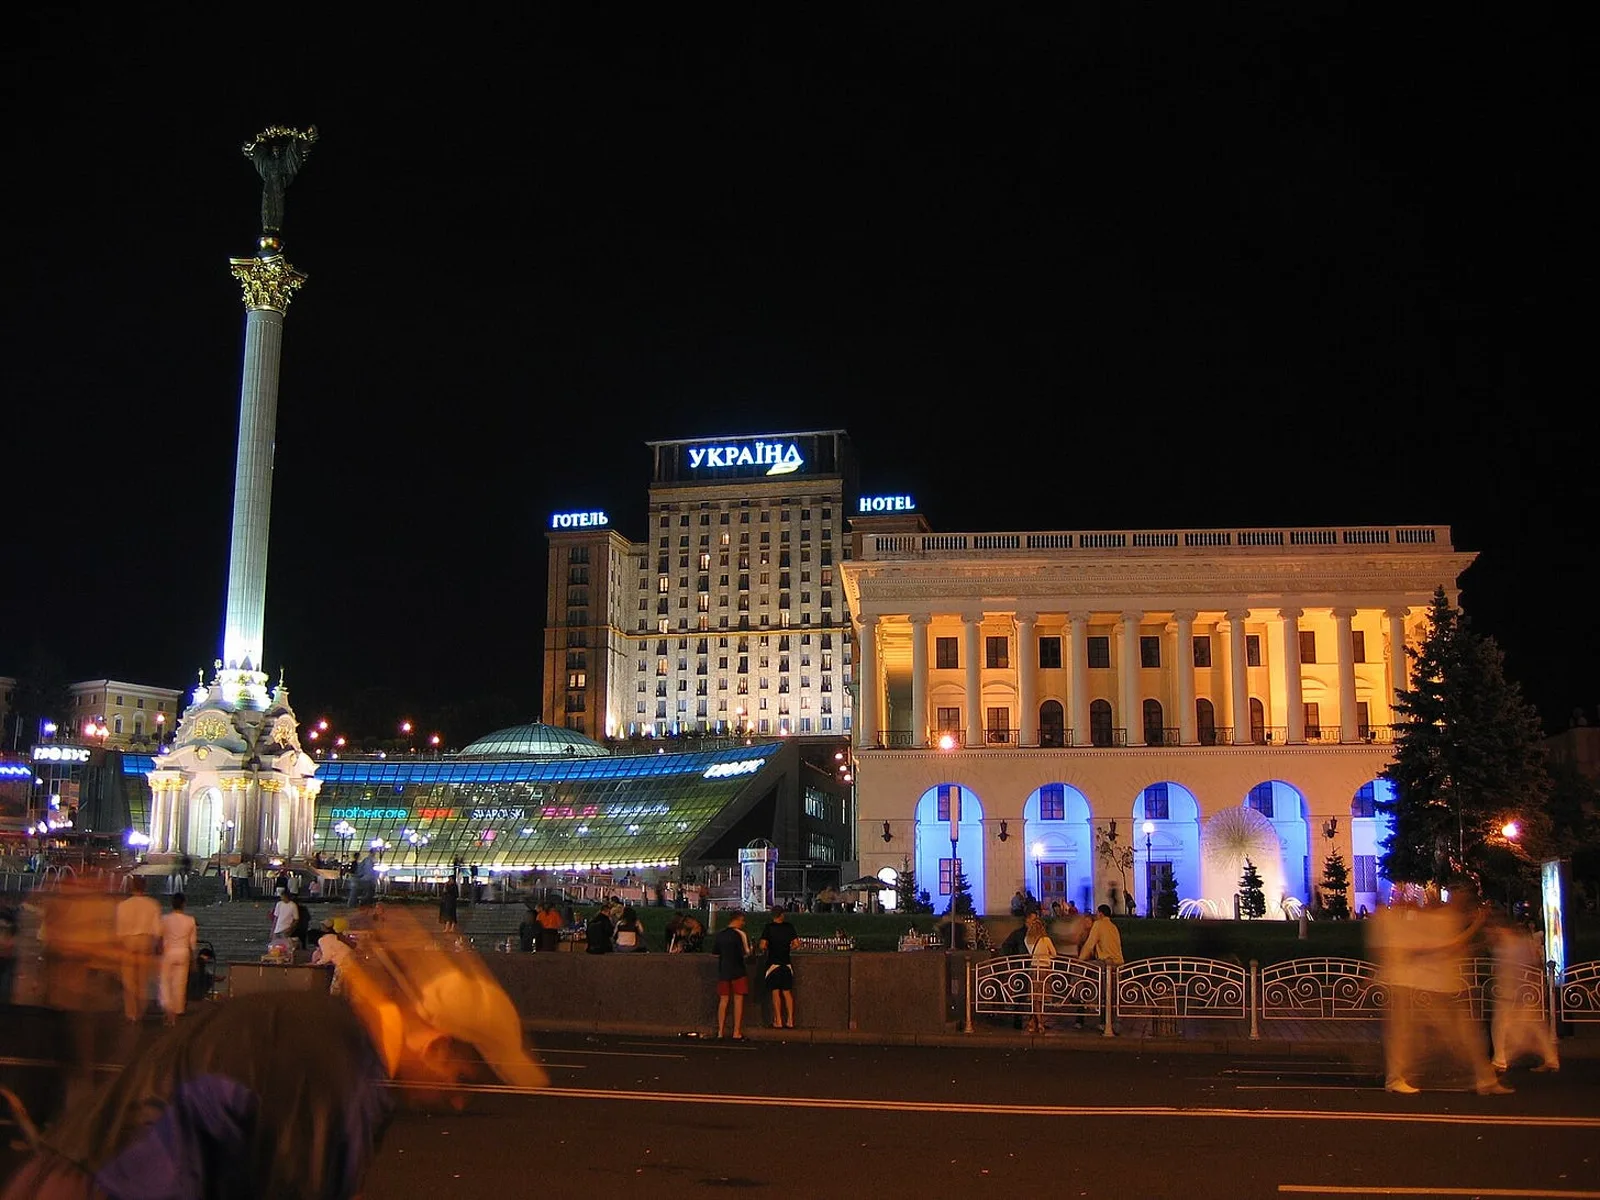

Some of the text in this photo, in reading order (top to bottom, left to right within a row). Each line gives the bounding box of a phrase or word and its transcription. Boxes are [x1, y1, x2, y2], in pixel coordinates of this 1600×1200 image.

[689, 442, 804, 468] УКРАЇНА
[859, 496, 915, 512] HOTEL
[552, 511, 608, 528] ГОТЕЛЬ
[331, 806, 407, 819] mothercare
[471, 807, 525, 820] SWAROVSKI
